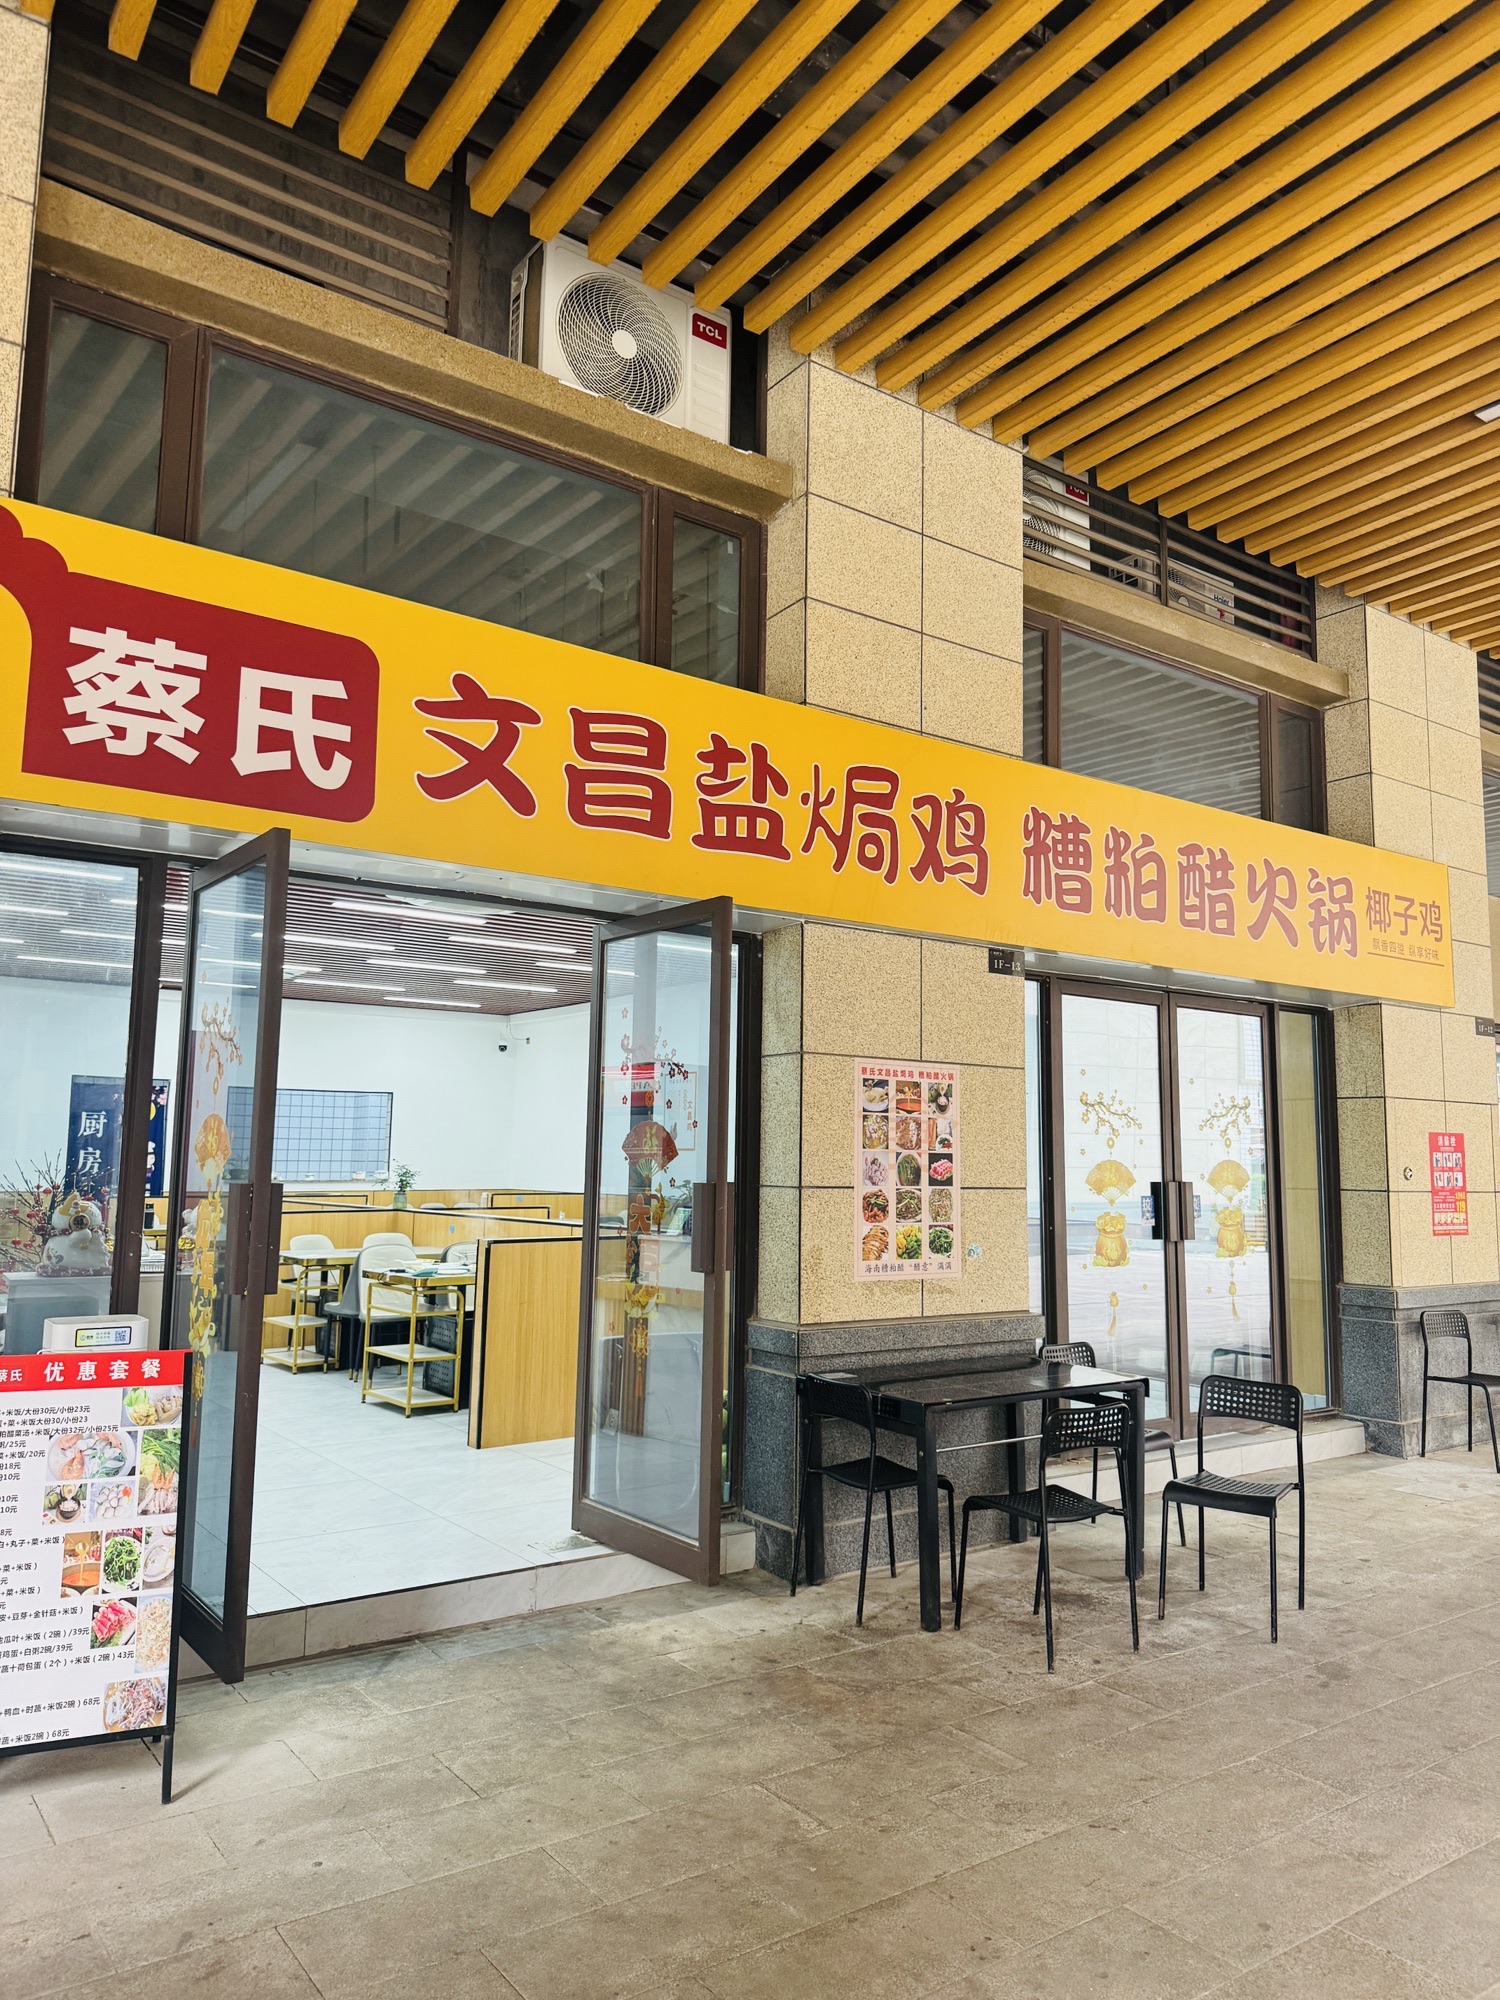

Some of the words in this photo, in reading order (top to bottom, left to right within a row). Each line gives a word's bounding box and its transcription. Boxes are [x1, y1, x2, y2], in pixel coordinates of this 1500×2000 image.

[697, 321, 723, 340] TCL
[62, 626, 353, 790] 蔡氏
[413, 671, 989, 896] 文昌盐焗鸡
[1021, 805, 1359, 959] 糟粕醋火锅
[1365, 886, 1444, 943] 椰子鸡
[994, 959, 1021, 971] 1F-13
[43, 1358, 161, 1383] 优惠套餐
[0, 1405, 91, 1417] +米饭/大份30元/小份23元
[0, 1416, 88, 1428] +菜+米饭大份30/小份23
